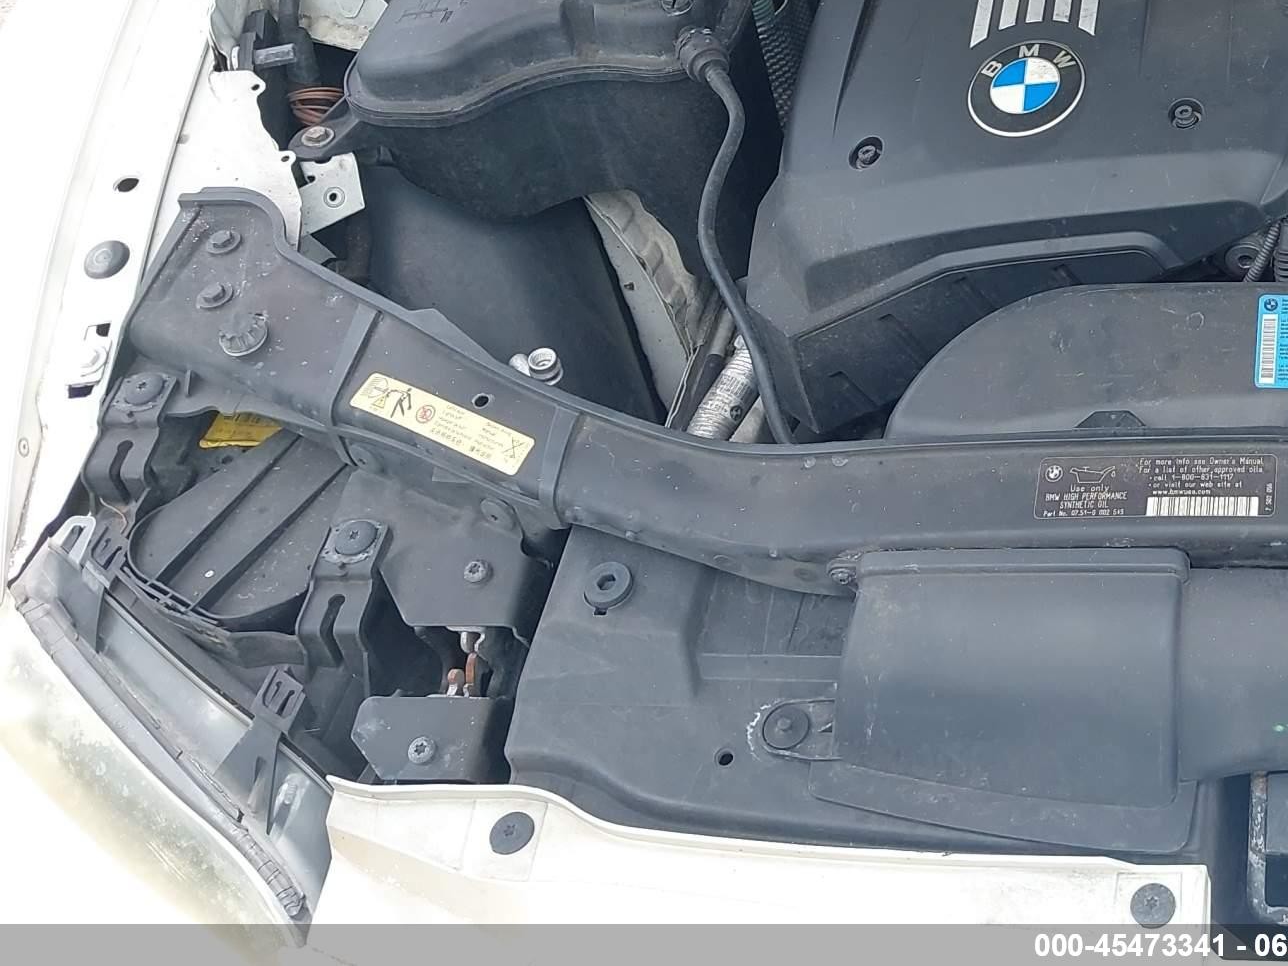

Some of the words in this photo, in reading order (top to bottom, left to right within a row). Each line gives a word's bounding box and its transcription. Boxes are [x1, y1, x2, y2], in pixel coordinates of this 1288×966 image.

[981, 43, 1076, 78] BMW
[1139, 458, 1152, 466] For
[1176, 457, 1190, 465] info
[1209, 457, 1236, 465] Owner's
[1239, 457, 1264, 465] Manual
[1138, 466, 1151, 474] For
[1213, 466, 1245, 474] approved
[1070, 483, 1086, 492] Use
[1090, 483, 1110, 493] only
[1045, 493, 1061, 502] BMW
[1063, 492, 1079, 501] HIGH
[1081, 491, 1128, 501] PERFORMANCE
[1059, 501, 1095, 510] SYNTHETIC
[1097, 500, 1109, 509] OIL
